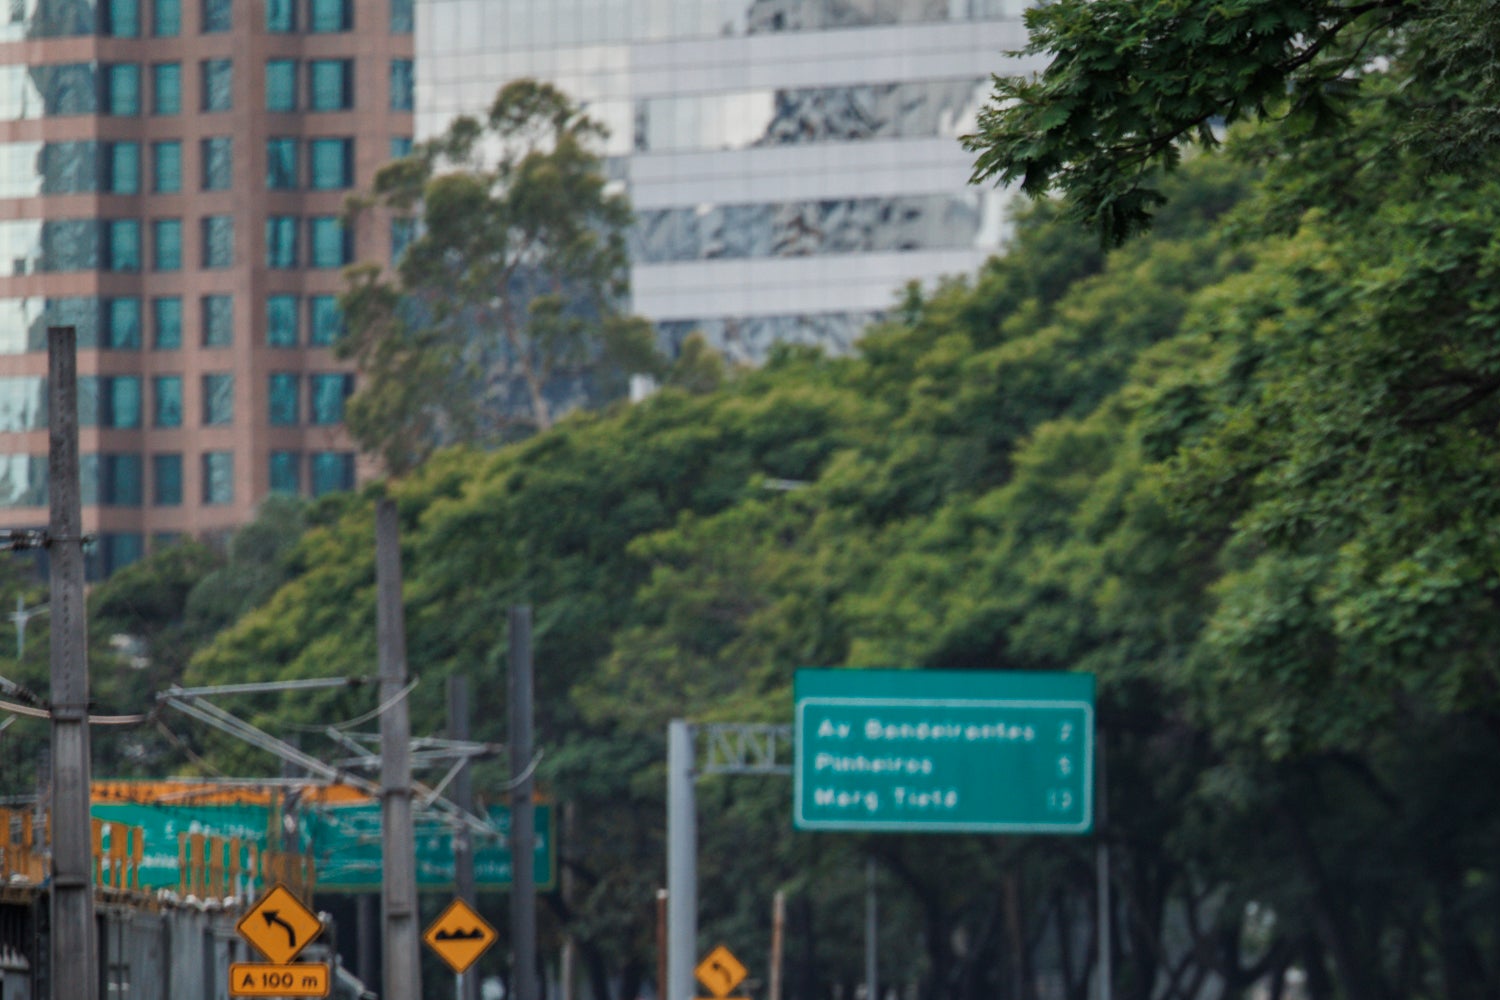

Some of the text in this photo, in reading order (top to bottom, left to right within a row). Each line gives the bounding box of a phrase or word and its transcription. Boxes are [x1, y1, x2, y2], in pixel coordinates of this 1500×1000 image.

[818, 719, 850, 738] Av
[243, 972, 318, 988] A 100 m
